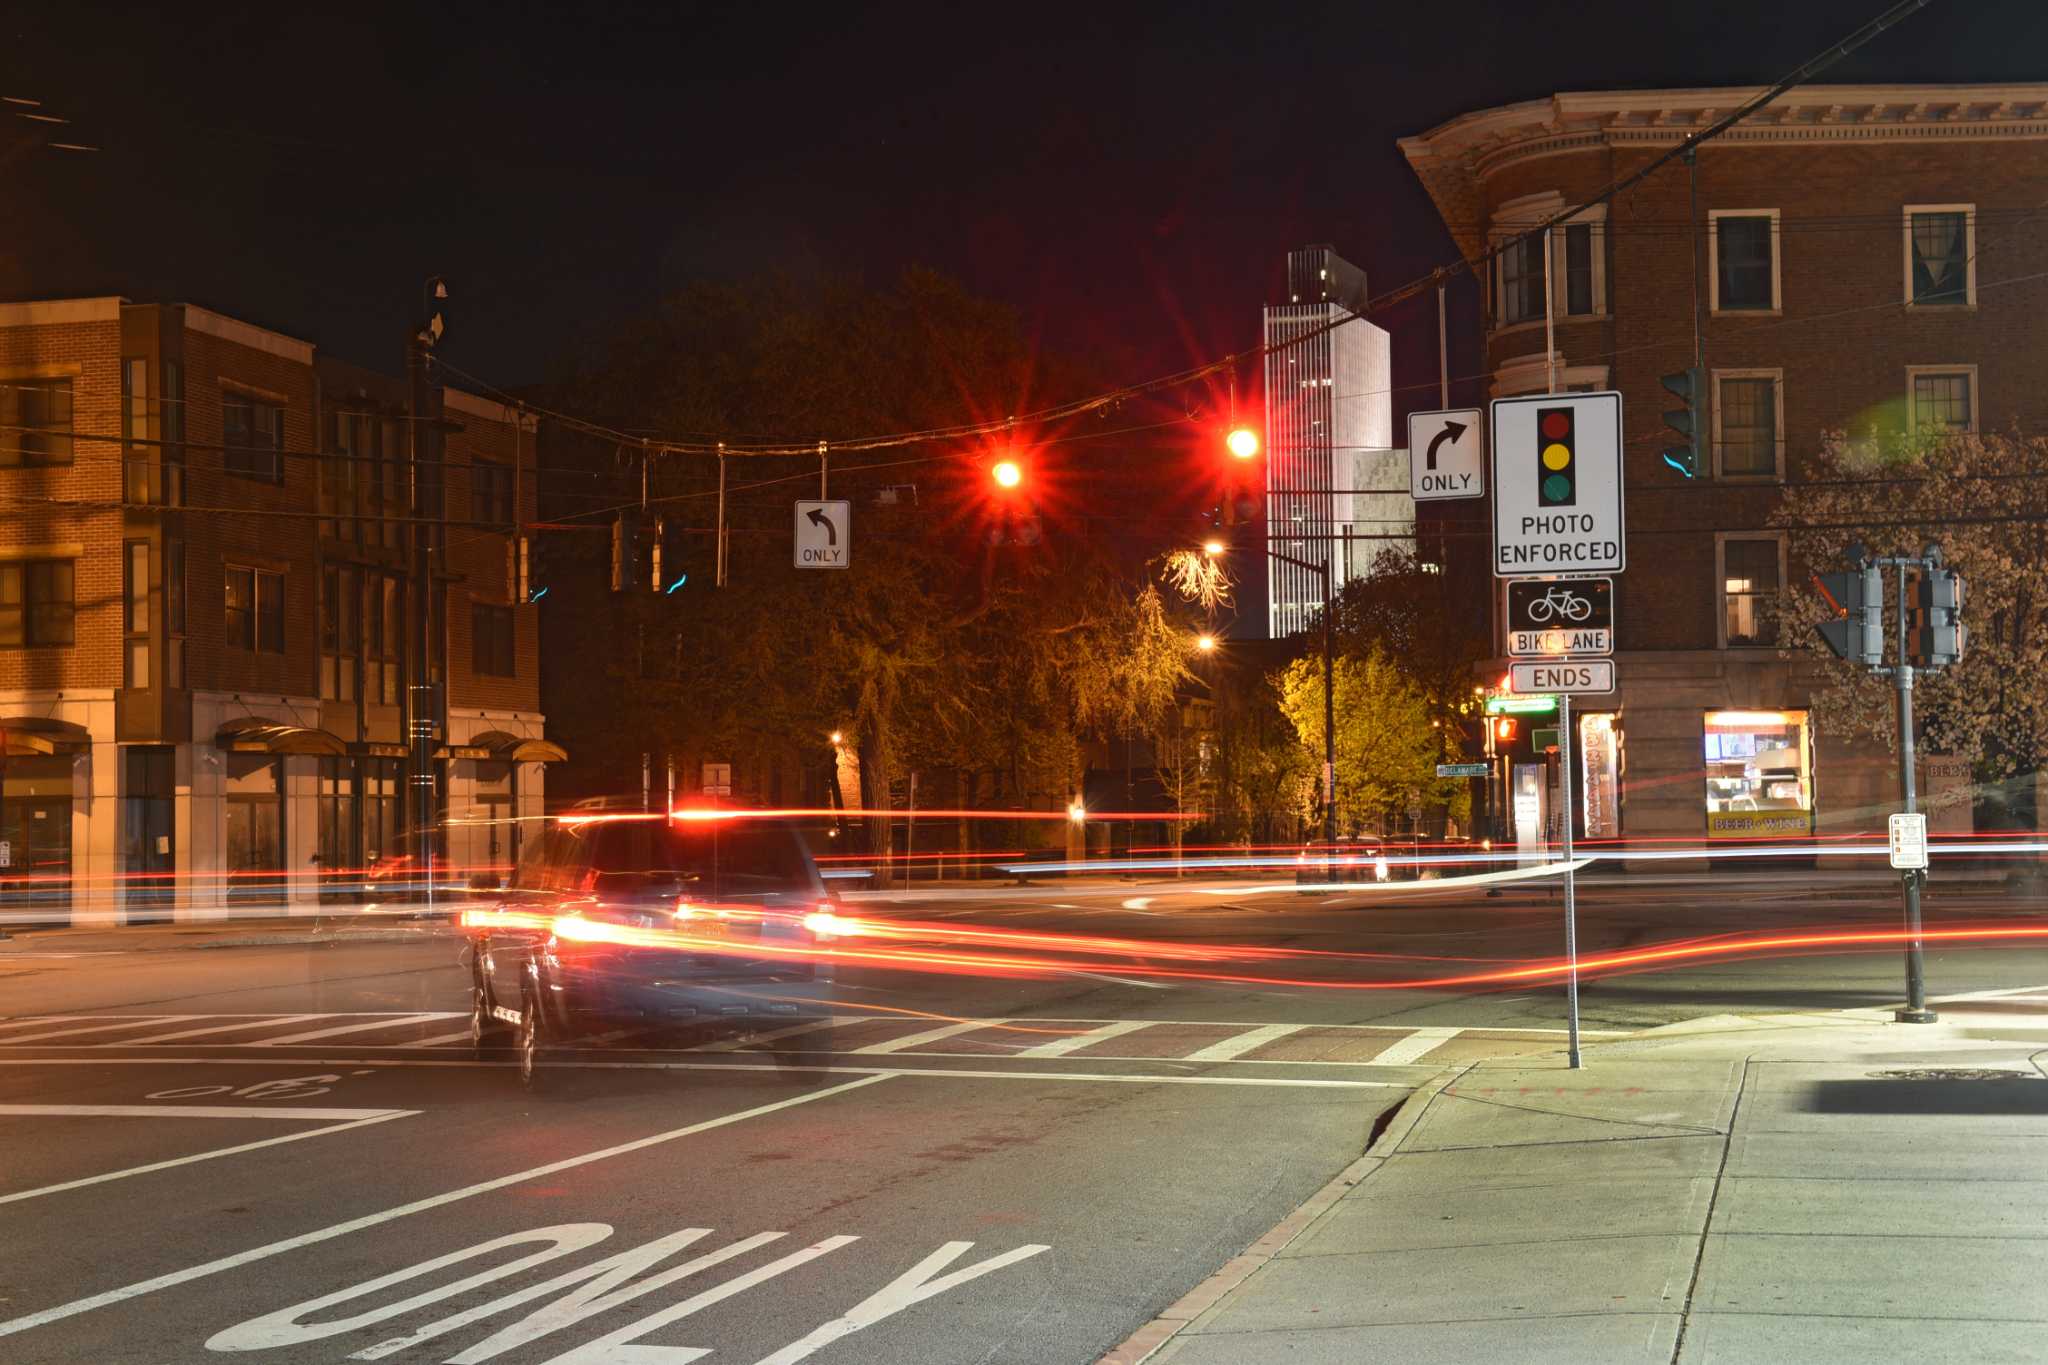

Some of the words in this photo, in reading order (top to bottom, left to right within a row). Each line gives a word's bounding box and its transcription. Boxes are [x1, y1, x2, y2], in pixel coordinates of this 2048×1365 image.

[1421, 473, 1472, 491] ONLY
[1522, 514, 1594, 535] PHOTO
[803, 549, 840, 562] ONLY
[1500, 541, 1617, 564] ENFORCED
[1518, 634, 1554, 650] BIKE
[1563, 632, 1604, 649] LANE
[1533, 668, 1592, 687] ENDS
[1714, 817, 1753, 831] BEER
[1763, 816, 1808, 830] WINE
[204, 1222, 1051, 1365] ONLY
